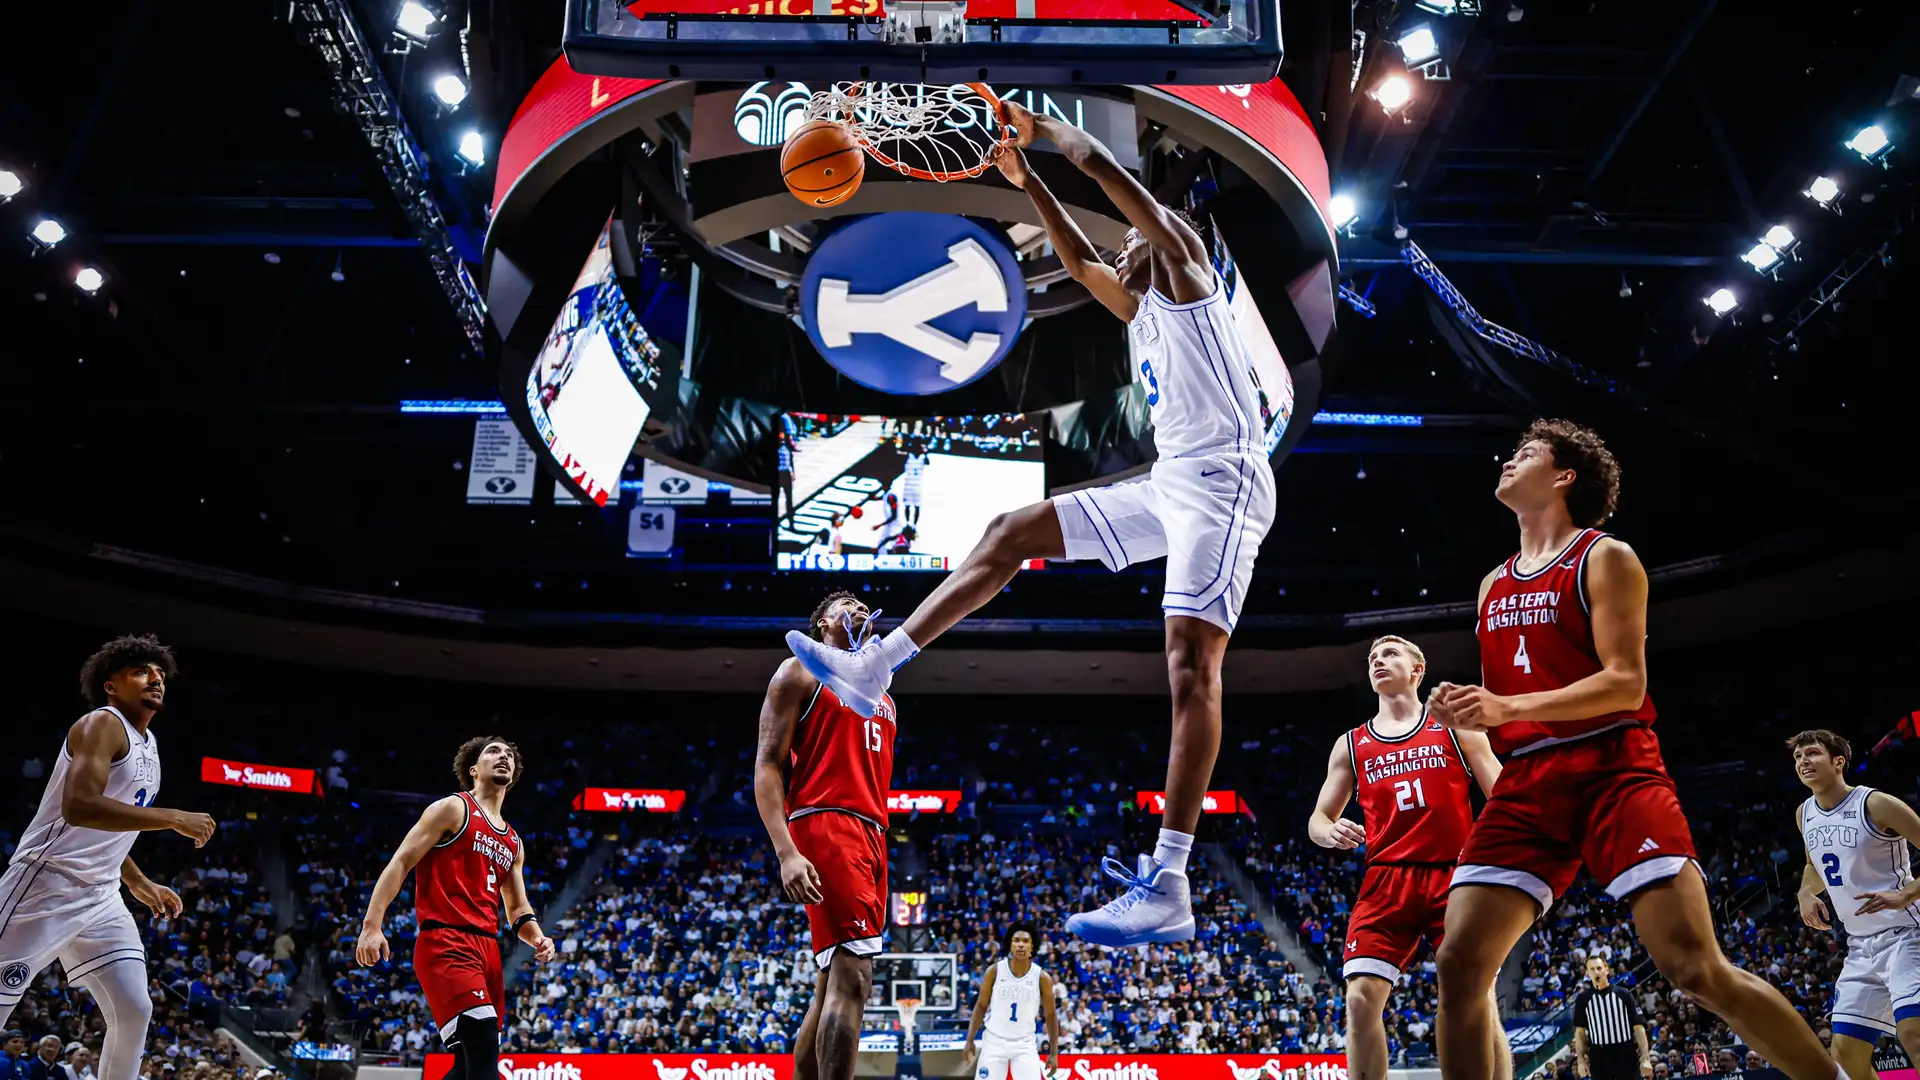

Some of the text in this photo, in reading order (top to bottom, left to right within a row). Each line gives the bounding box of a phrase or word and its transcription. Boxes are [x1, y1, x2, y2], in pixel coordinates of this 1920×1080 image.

[640, 512, 664, 530] 54
[1487, 591, 1560, 615] EASTERN
[1513, 635, 1531, 674] 4
[864, 719, 881, 752] 15
[1364, 745, 1443, 771] EASTERN
[1366, 757, 1447, 785] WASHINGTON
[242, 766, 291, 788] Smith's
[1394, 778, 1425, 811] 21
[475, 830, 514, 862] EASTERN
[1806, 824, 1858, 852] BYU
[473, 841, 511, 872] WASHINGTO
[1821, 853, 1844, 887] 2
[486, 865, 497, 893] 2
[897, 905, 922, 926] 21
[1009, 1002, 1018, 1022] 1
[497, 1058, 582, 1080] Smith's
[691, 1058, 775, 1080] Smith's
[1074, 1059, 1158, 1080] Smith's
